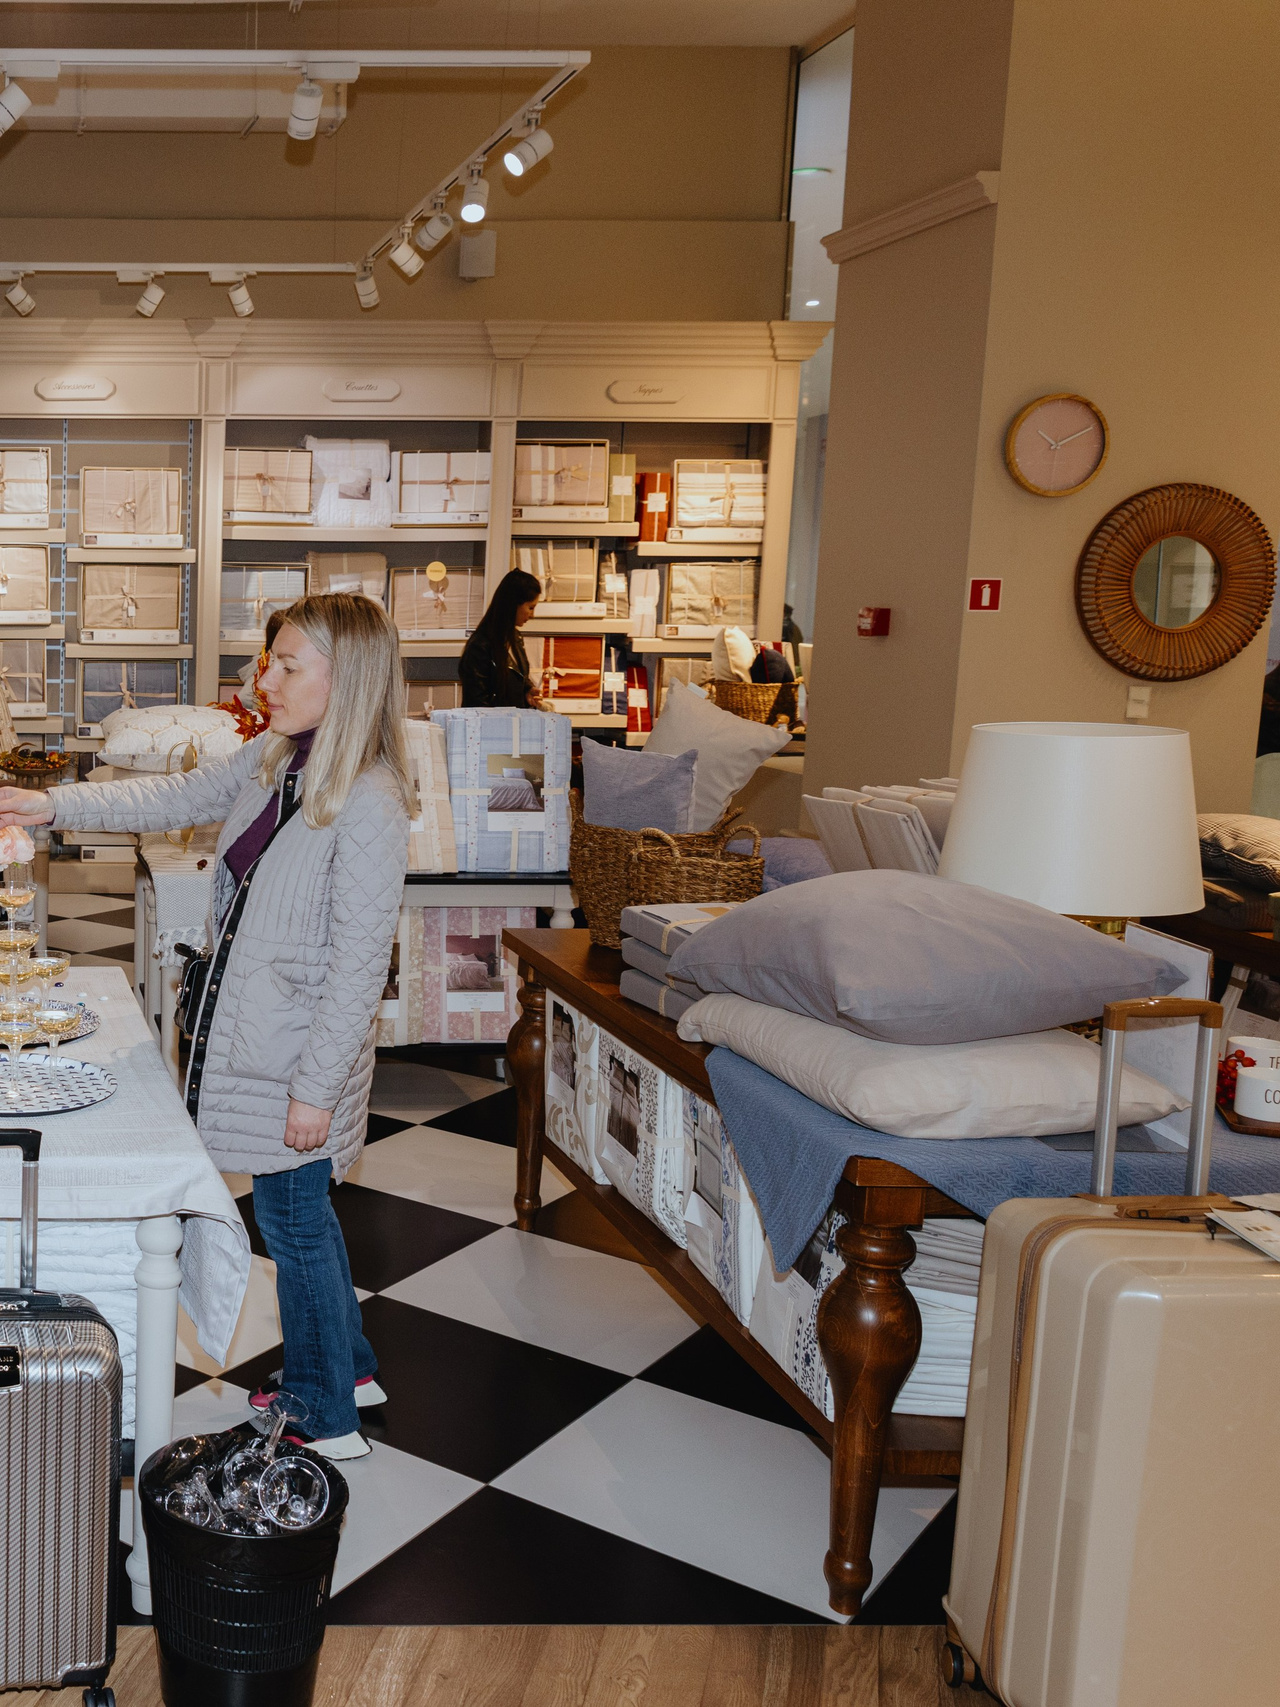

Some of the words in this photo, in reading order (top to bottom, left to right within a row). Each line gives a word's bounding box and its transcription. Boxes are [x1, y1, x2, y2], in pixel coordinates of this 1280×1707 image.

[52, 381, 96, 391] Accessoires
[345, 381, 379, 391] Couettes
[633, 384, 663, 396] Nappes
